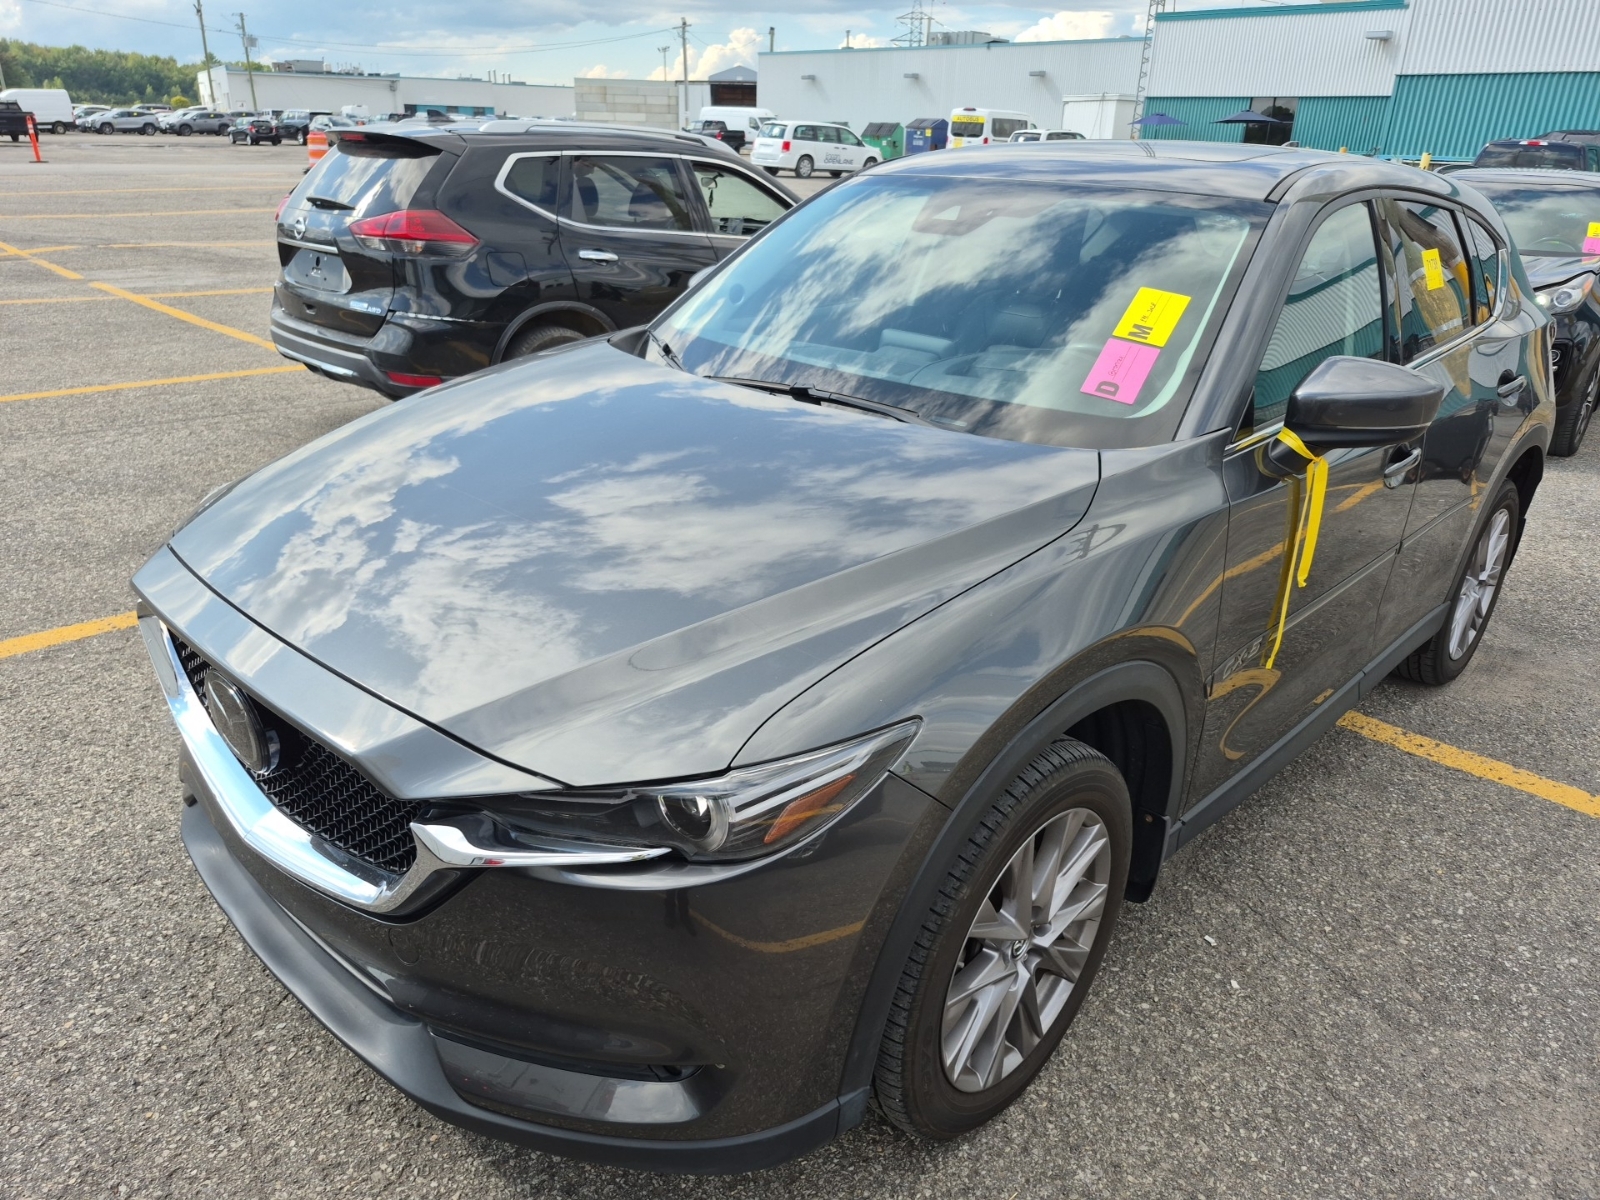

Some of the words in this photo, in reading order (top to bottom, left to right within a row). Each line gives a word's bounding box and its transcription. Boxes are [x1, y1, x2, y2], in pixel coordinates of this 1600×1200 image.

[368, 306, 382, 314] AWD
[1127, 323, 1154, 341] M
[1095, 380, 1120, 397] D
[1223, 636, 1263, 680] CX-5
